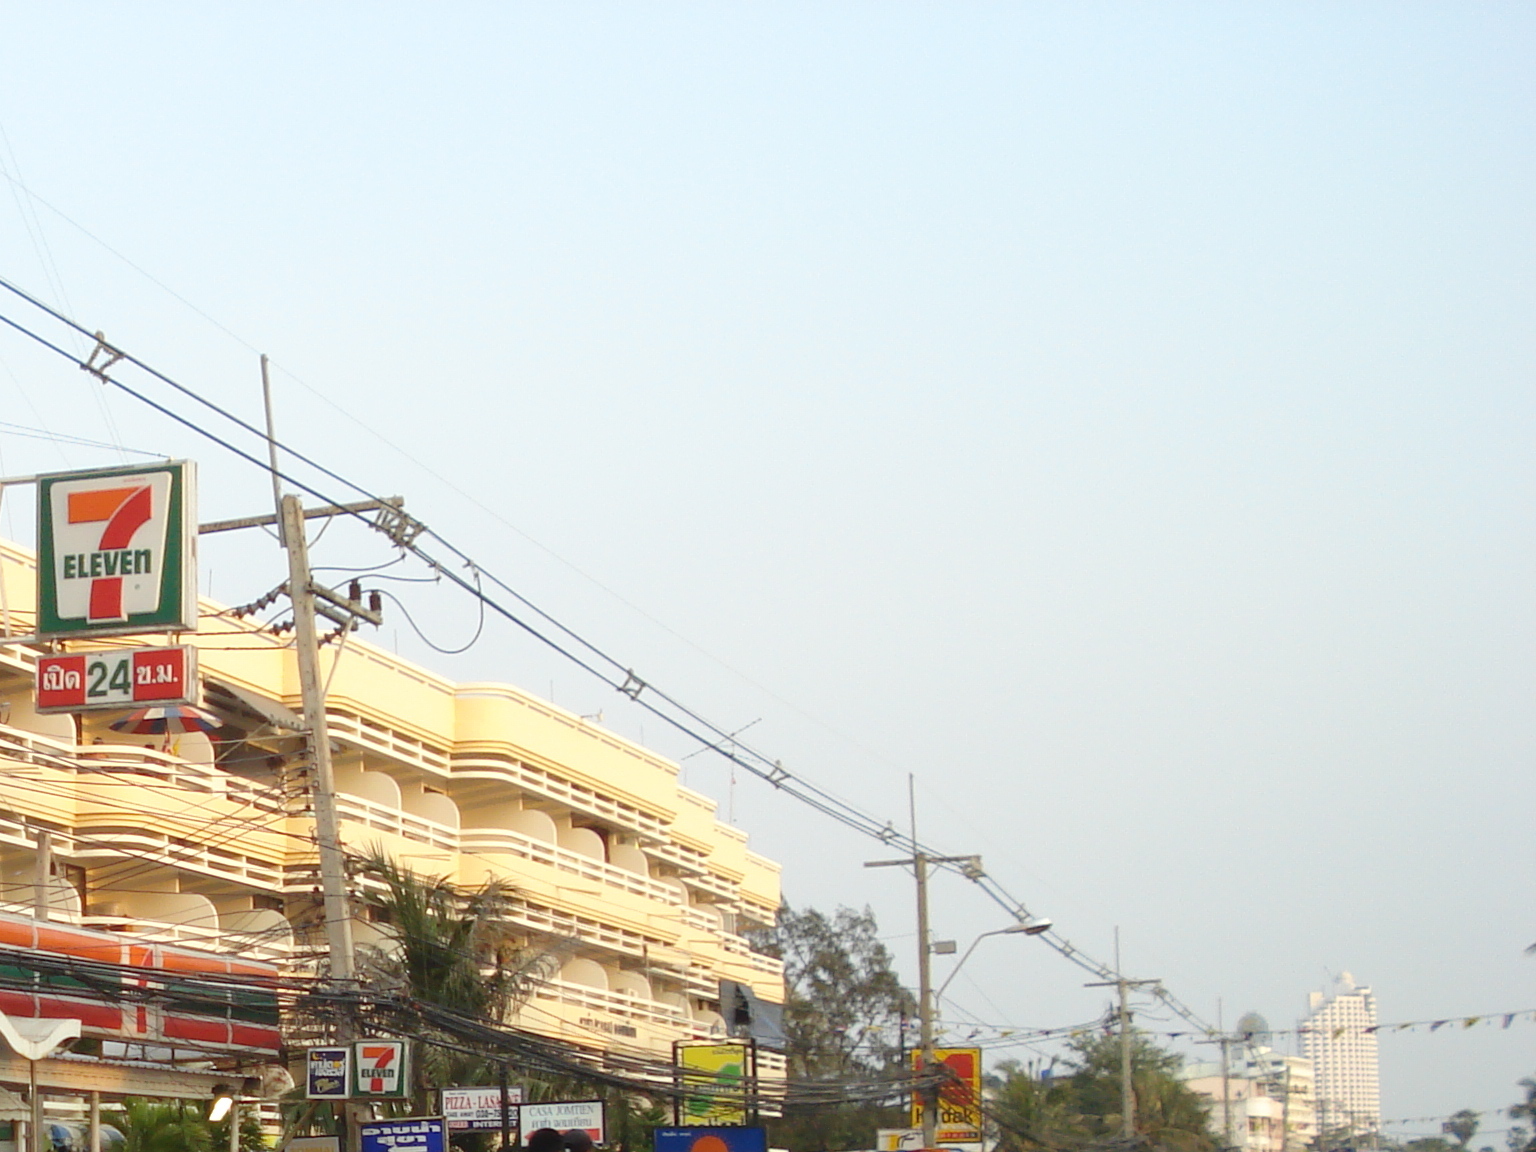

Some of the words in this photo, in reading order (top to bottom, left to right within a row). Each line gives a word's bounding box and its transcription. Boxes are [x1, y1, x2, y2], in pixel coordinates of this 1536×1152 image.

[67, 484, 152, 619] 7
[43, 664, 81, 692] เปิด
[87, 658, 131, 698] 24
[362, 1047, 395, 1091] 7
[445, 1096, 472, 1110] PIZZA
[529, 1106, 553, 1117] CASA
[556, 1104, 594, 1116] JOMTIEN
